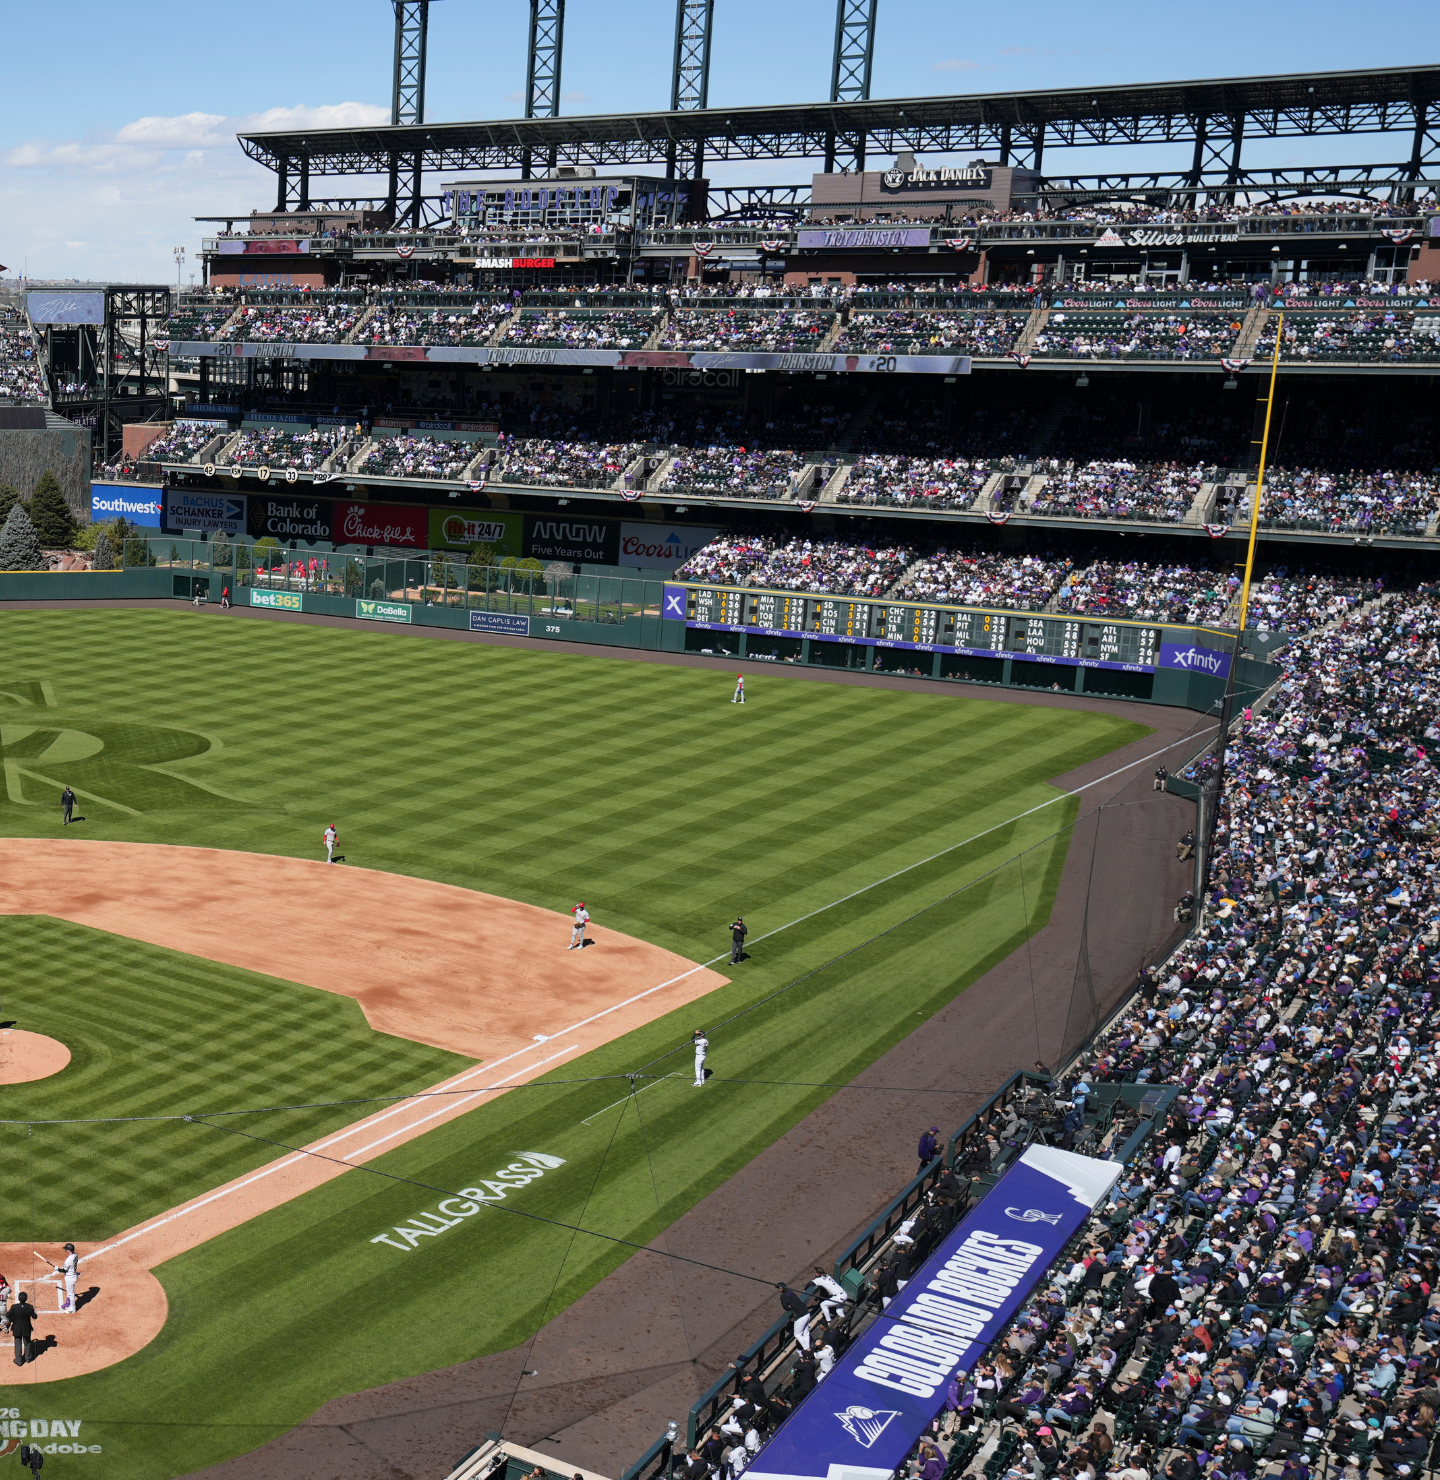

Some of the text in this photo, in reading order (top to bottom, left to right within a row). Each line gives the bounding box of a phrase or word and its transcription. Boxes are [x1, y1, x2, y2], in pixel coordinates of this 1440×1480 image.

[908, 167, 937, 182] JACK
[443, 187, 619, 212] THE ROOFTOP
[823, 231, 909, 247] TROY JOHNSTON
[1127, 229, 1239, 246] Silver BULLET BAR
[1063, 298, 1177, 308] Coors LIGHT Coors LIGHT
[1285, 298, 1313, 308] Coors
[254, 345, 296, 357] JOHNSTON
[486, 349, 556, 364] TROY JOHNSTON
[777, 354, 897, 372] JOHNSTON #20
[193, 404, 234, 413] FLECHA AZUL
[385, 420, 411, 428] birdcall
[425, 422, 452, 430] birdcall
[287, 472, 296, 481] 33
[92, 496, 156, 515] Southwest
[183, 495, 224, 508] BACHUS
[169, 505, 224, 520] SCHANKER
[267, 502, 319, 519] Bank of
[175, 517, 238, 530] INJURY LAWYERS
[267, 518, 330, 537] Colorado
[447, 519, 505, 538] Fix-it 24/7
[531, 544, 604, 560] Five Years Out
[622, 536, 674, 560] Coors
[252, 591, 300, 608] bet365
[698, 590, 712, 598] LAD
[760, 596, 774, 604] MIA
[377, 605, 407, 617] DaBella
[760, 604, 775, 612] NYY
[823, 610, 838, 618] BOS
[889, 607, 905, 616] CHC
[472, 615, 527, 626] DAN CAPLIS LAW
[759, 612, 773, 620] TOR
[957, 613, 972, 622] BAL
[545, 625, 560, 633] 375
[1029, 619, 1044, 628] SEA
[1102, 625, 1117, 635] ATL
[1026, 637, 1045, 646] HOU
[1101, 644, 1119, 654] NYM
[1079, 659, 1100, 668] xfinity
[1173, 648, 1222, 673] xfinity
[369, 1163, 545, 1251] TALLGRASS
[853, 1230, 1044, 1399] COLORADO ROCKIES
[30, 1419, 82, 1438] DAY
[29, 1442, 103, 1454] Adobe
